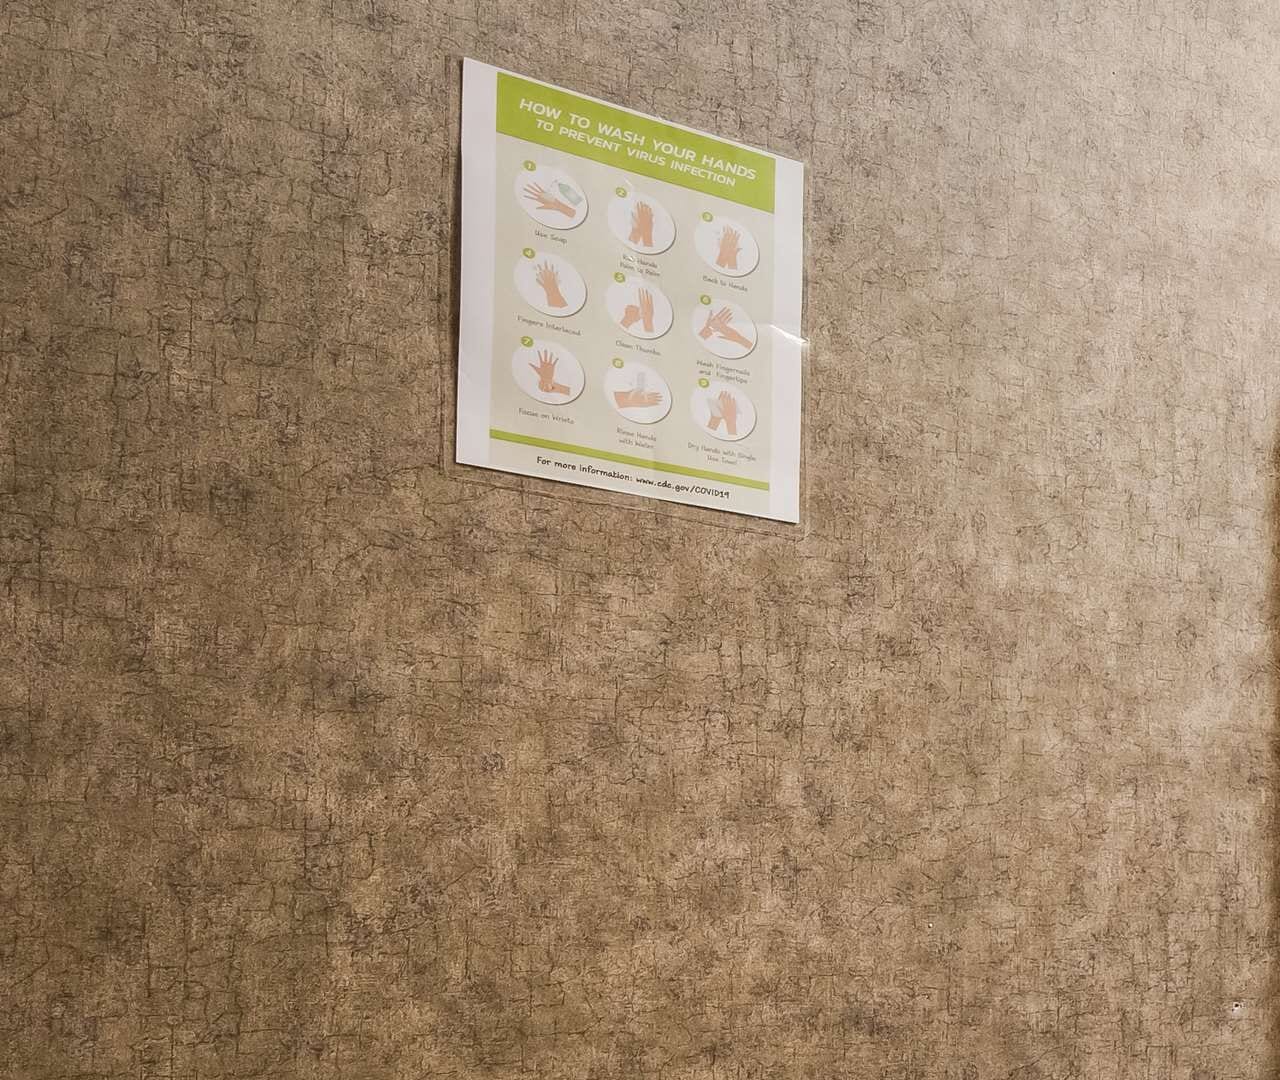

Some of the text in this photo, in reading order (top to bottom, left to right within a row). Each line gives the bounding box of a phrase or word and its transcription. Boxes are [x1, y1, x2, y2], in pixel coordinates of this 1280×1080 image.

[519, 98, 757, 180] HOW TO WASH YOUR HANDS
[536, 119, 736, 186] TO PREVENT VIRUS INFECTION
[536, 456, 552, 467] For
[554, 461, 576, 471] more
[579, 464, 633, 482] information:
